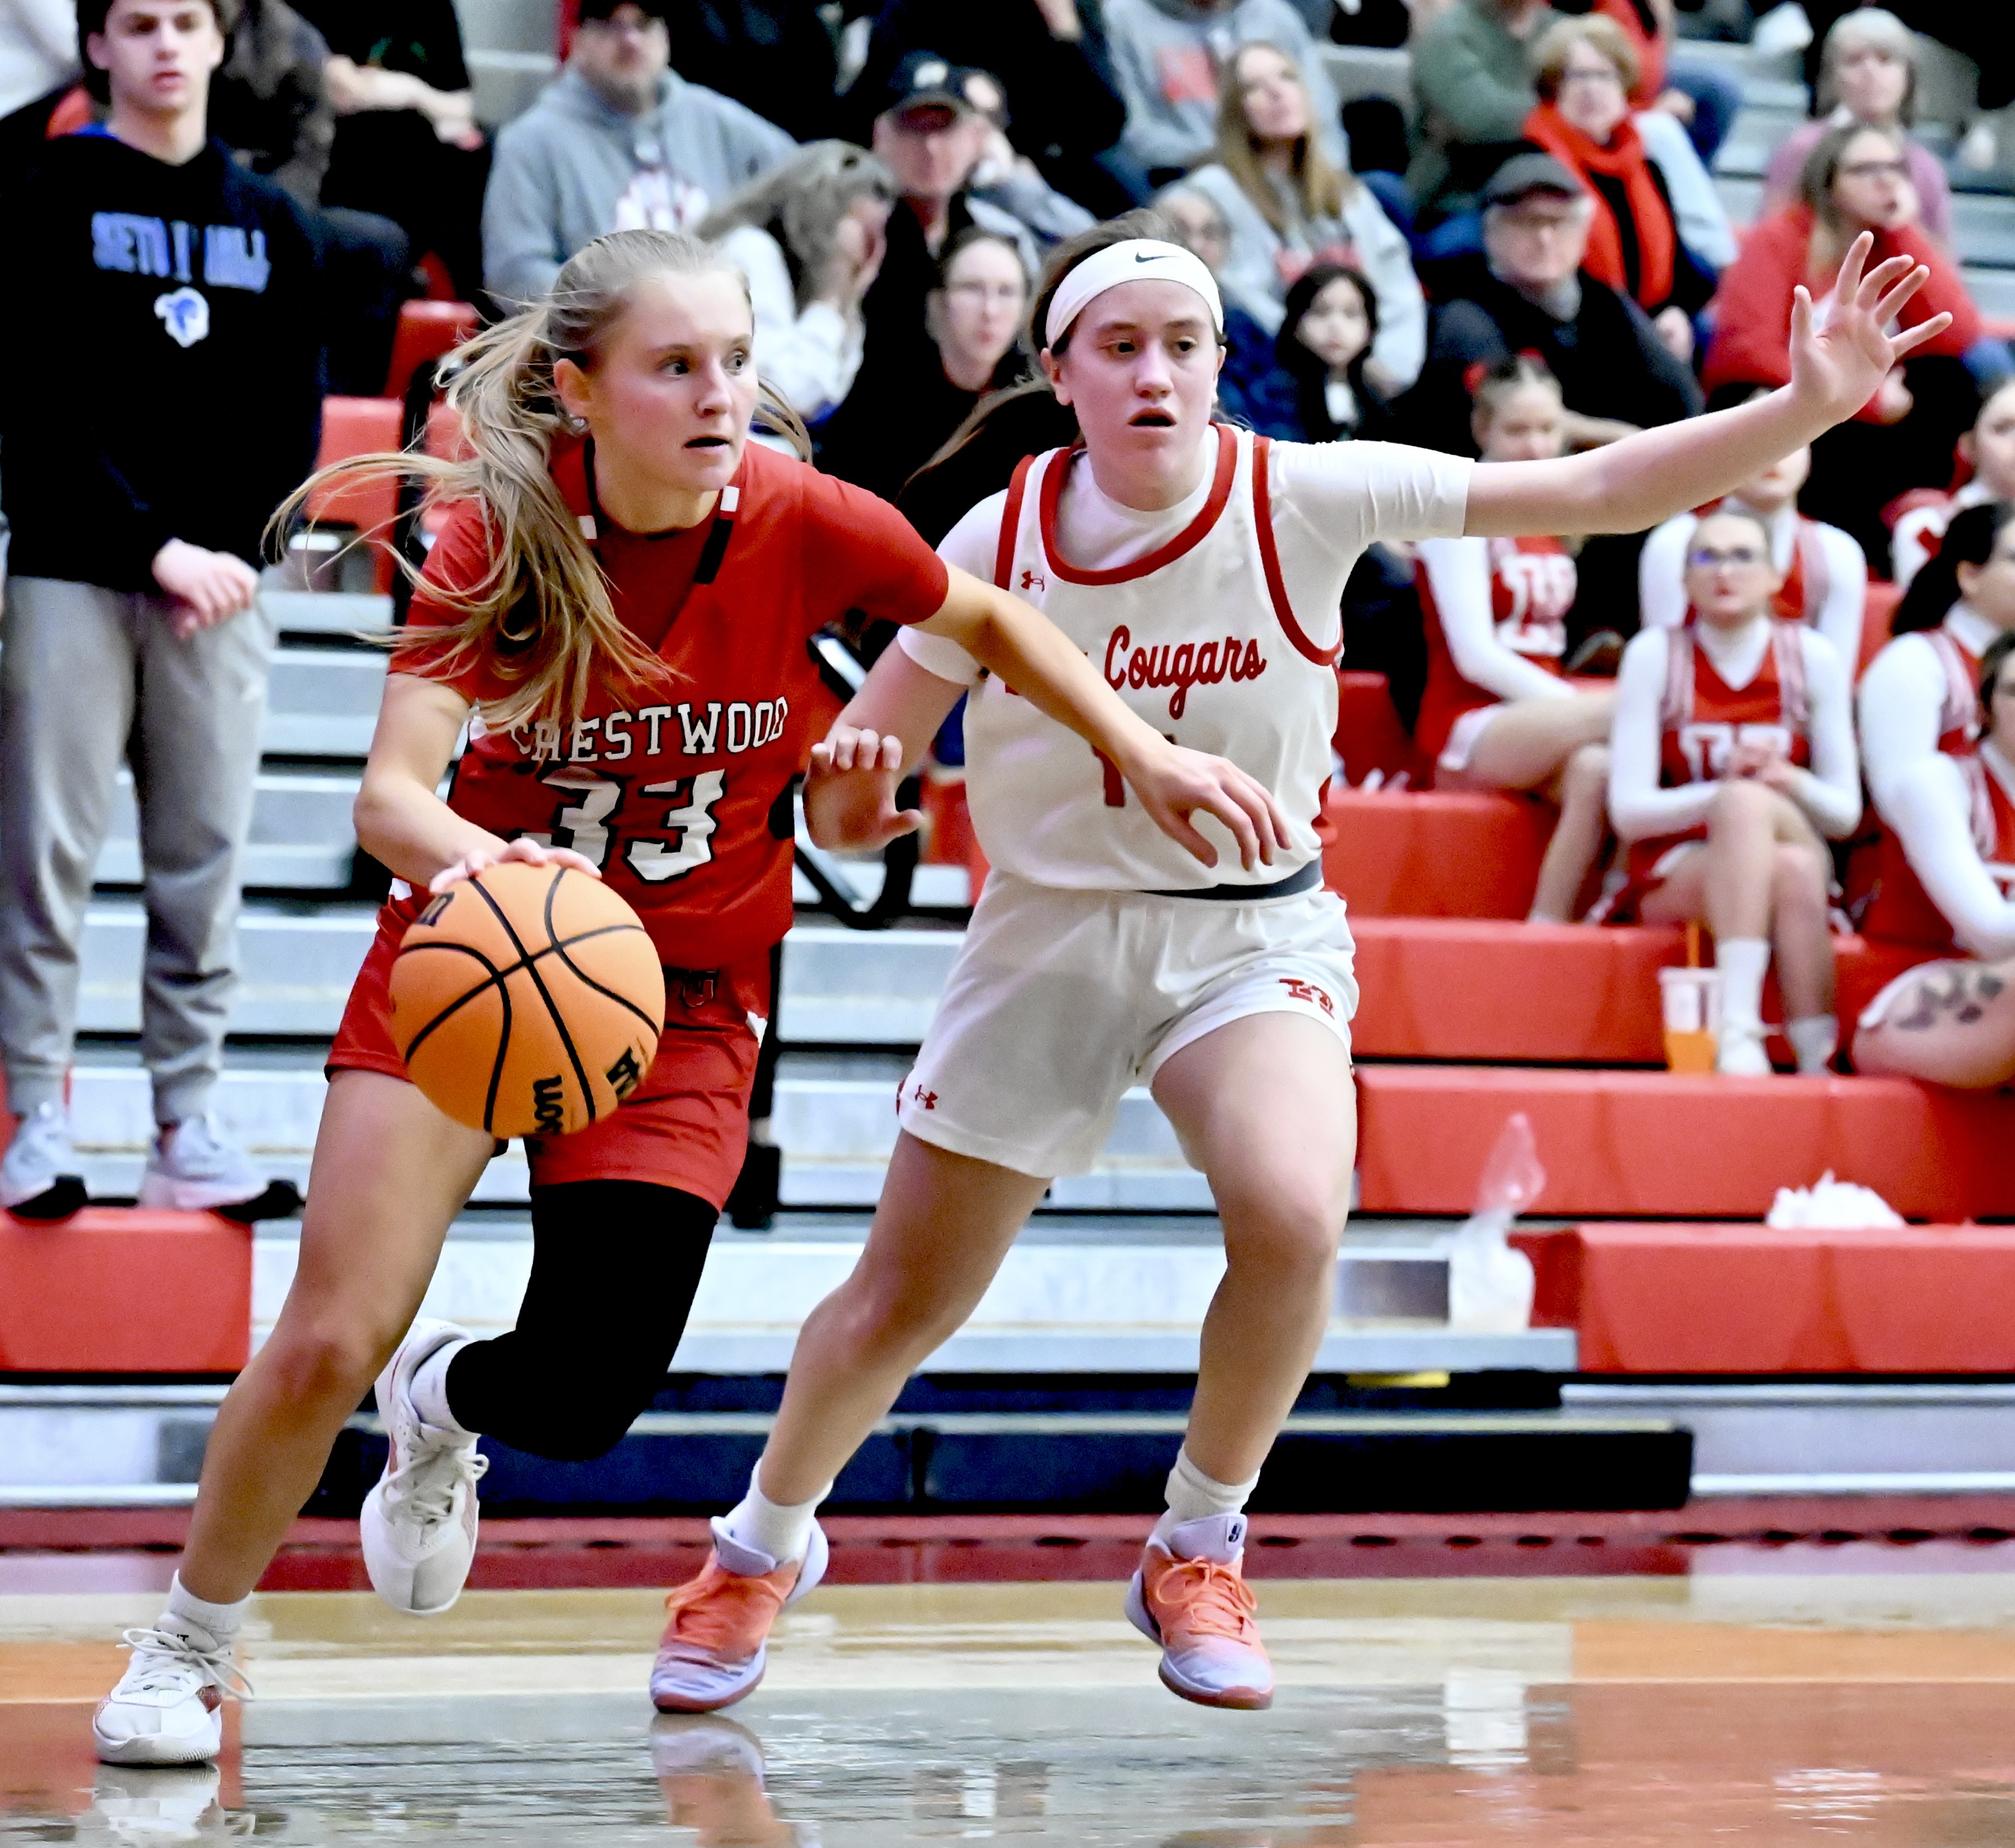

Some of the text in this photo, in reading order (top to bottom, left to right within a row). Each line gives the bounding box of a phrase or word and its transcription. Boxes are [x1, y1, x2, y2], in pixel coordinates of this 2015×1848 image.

[1104, 625, 1267, 720] Cougars
[509, 696, 788, 762] CRESTWOOD
[520, 766, 725, 881] 33
